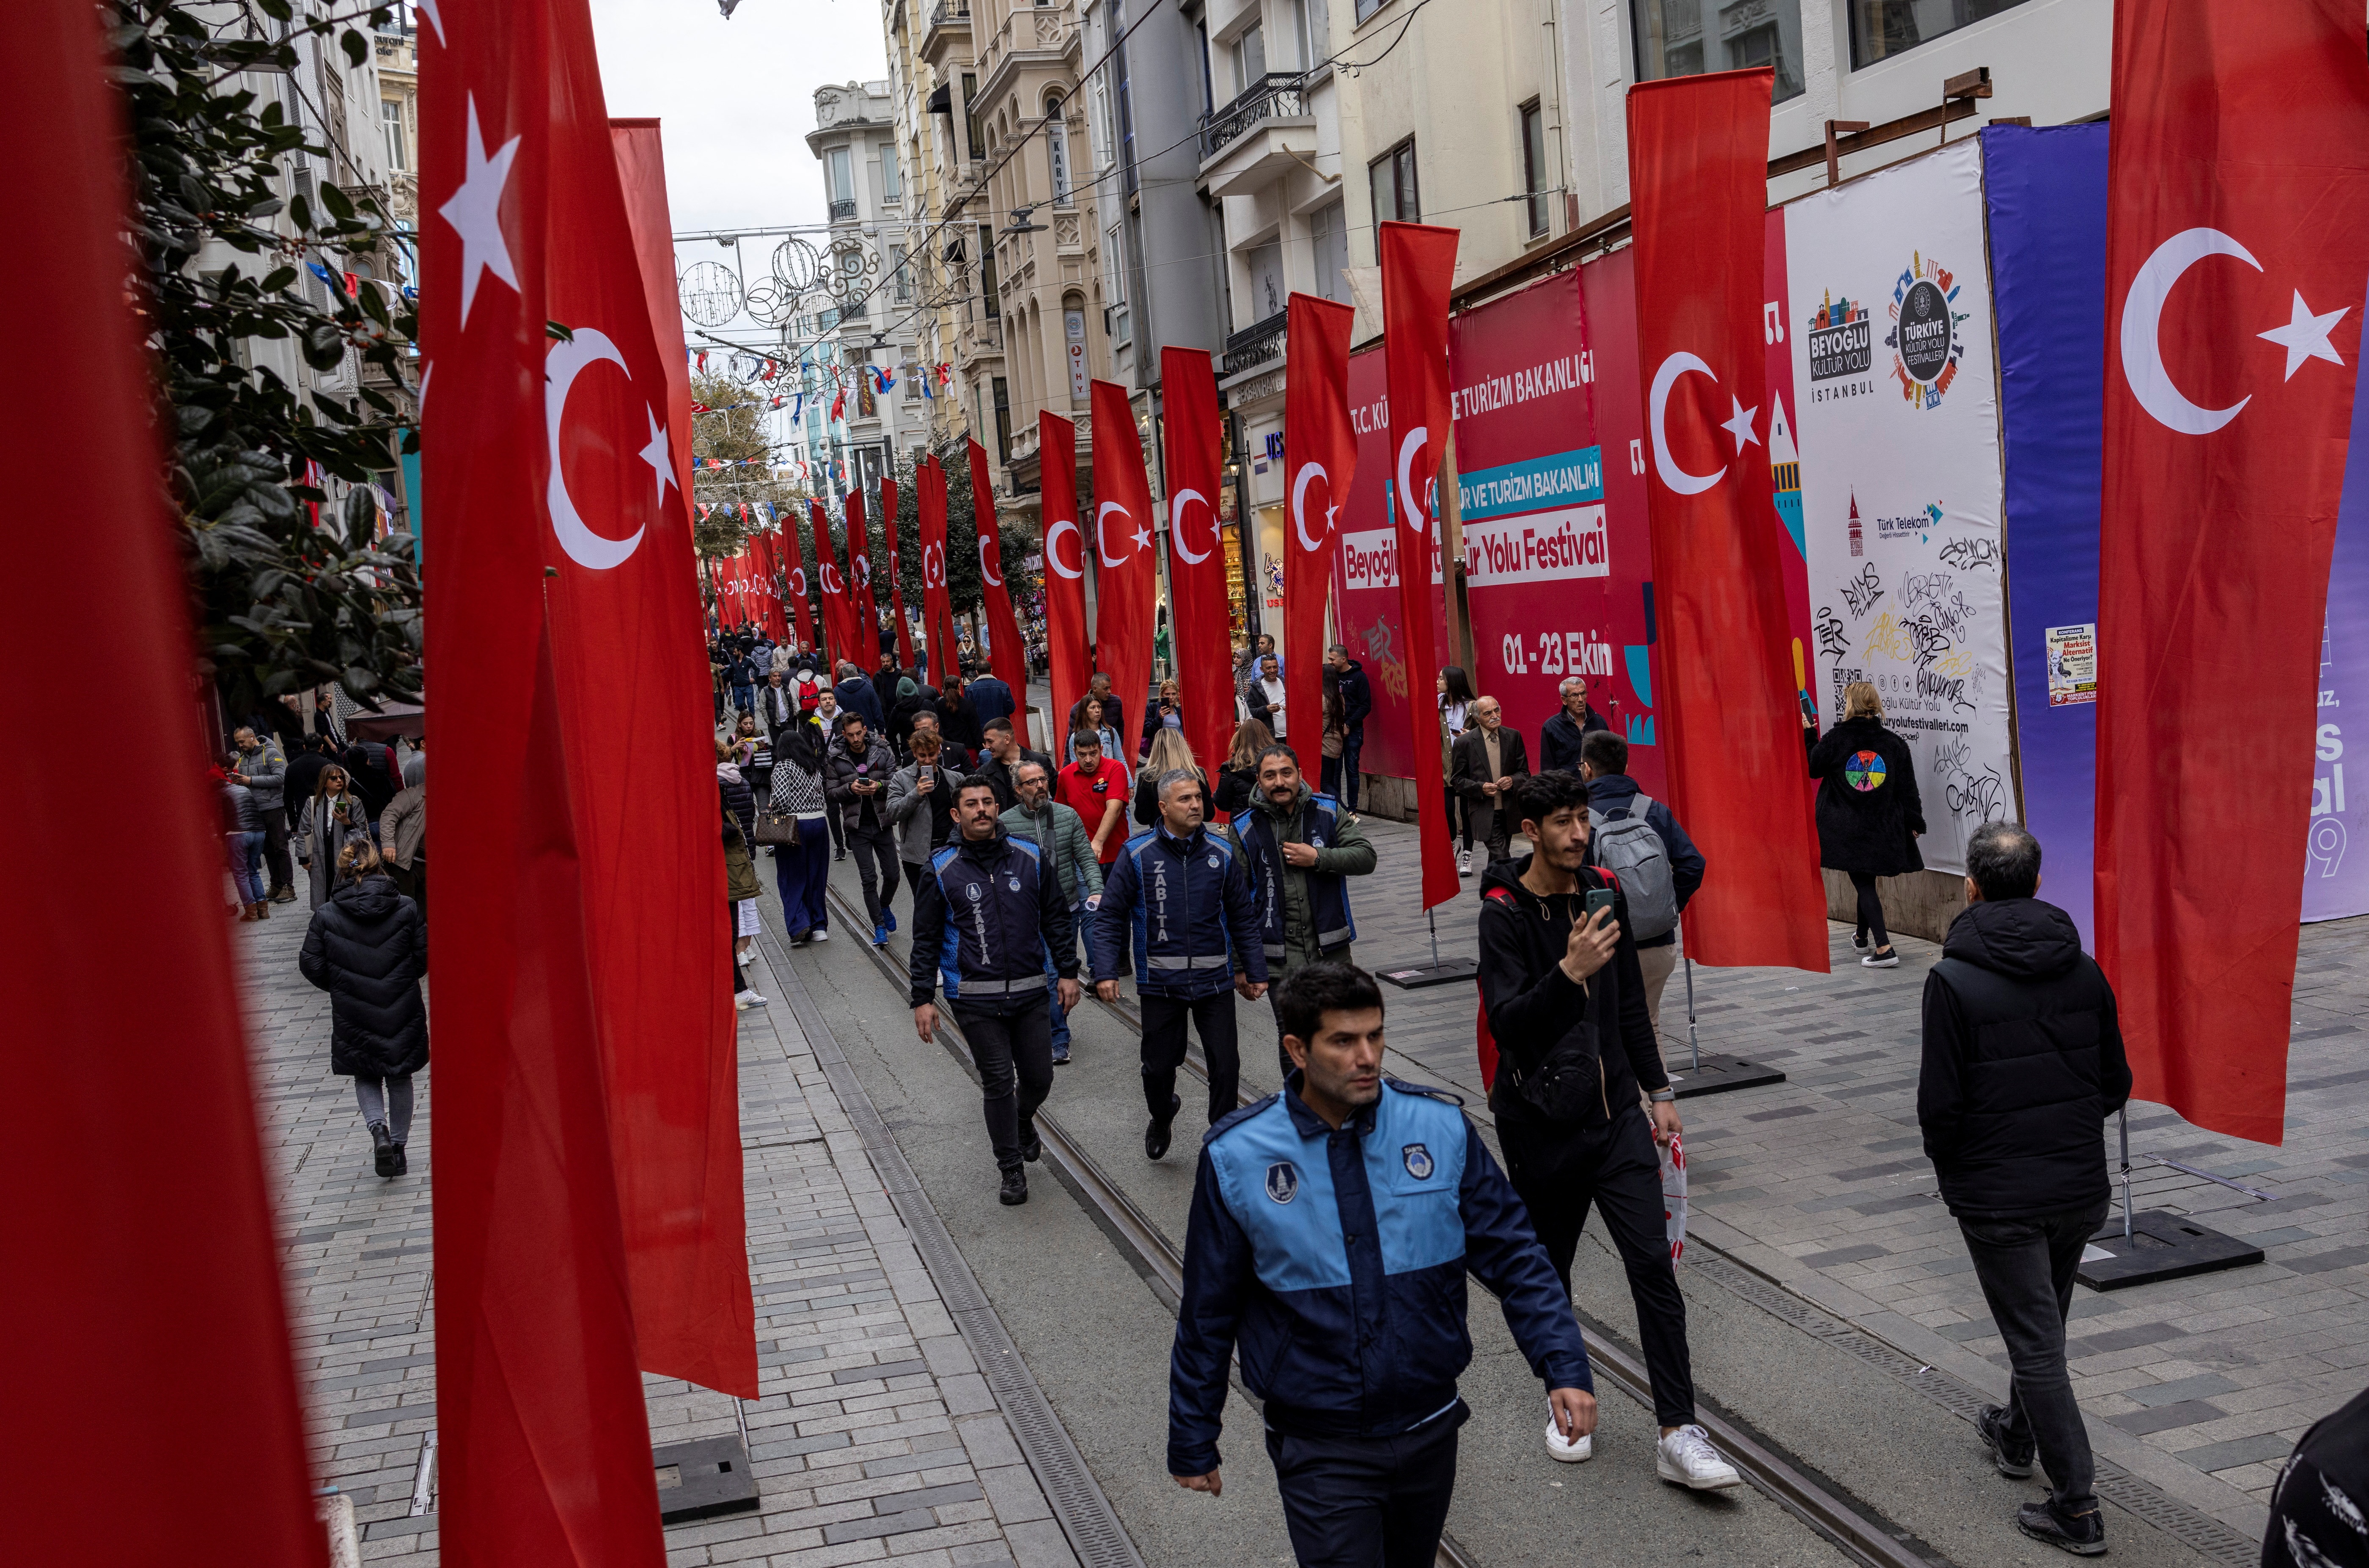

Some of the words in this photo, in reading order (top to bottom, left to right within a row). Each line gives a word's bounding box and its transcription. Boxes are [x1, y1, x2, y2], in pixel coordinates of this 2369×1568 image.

[1053, 141, 1064, 203] KARYA
[1905, 318, 1943, 341] TÜRKİYE
[1905, 339, 1927, 354] KÜLTÜR
[1927, 337, 1945, 349] YOLU
[1907, 347, 1944, 365] FESTİVALLERİ
[1812, 356, 1843, 376] KÜLTÜR
[1844, 350, 1869, 370] YOLU
[1075, 360, 1083, 393] THY
[1462, 374, 1513, 417] TURİZM
[1811, 380, 1873, 403] İSTANBUL
[1471, 487, 1488, 509] VE
[1488, 472, 1533, 506] TURİZM
[1877, 518, 1894, 531] Türk
[1896, 516, 1929, 529] Telekom
[1481, 532, 1520, 574] Yolu
[2050, 635, 2079, 643] Kapitalizme
[2062, 646, 2093, 656] Alternatif
[2064, 640, 2090, 649] Marksist
[1503, 634, 1528, 674] 01
[1540, 632, 1564, 675] 23
[1881, 697, 1897, 710] oğlu
[1899, 697, 1921, 710] Kültür
[1924, 699, 1940, 711] Yolu
[1881, 716, 1968, 733] turyolufestivalleri.com
[1154, 860, 1168, 942] ZABITA
[1265, 867, 1275, 928] ZABITA
[973, 903, 991, 965] ZABITA
